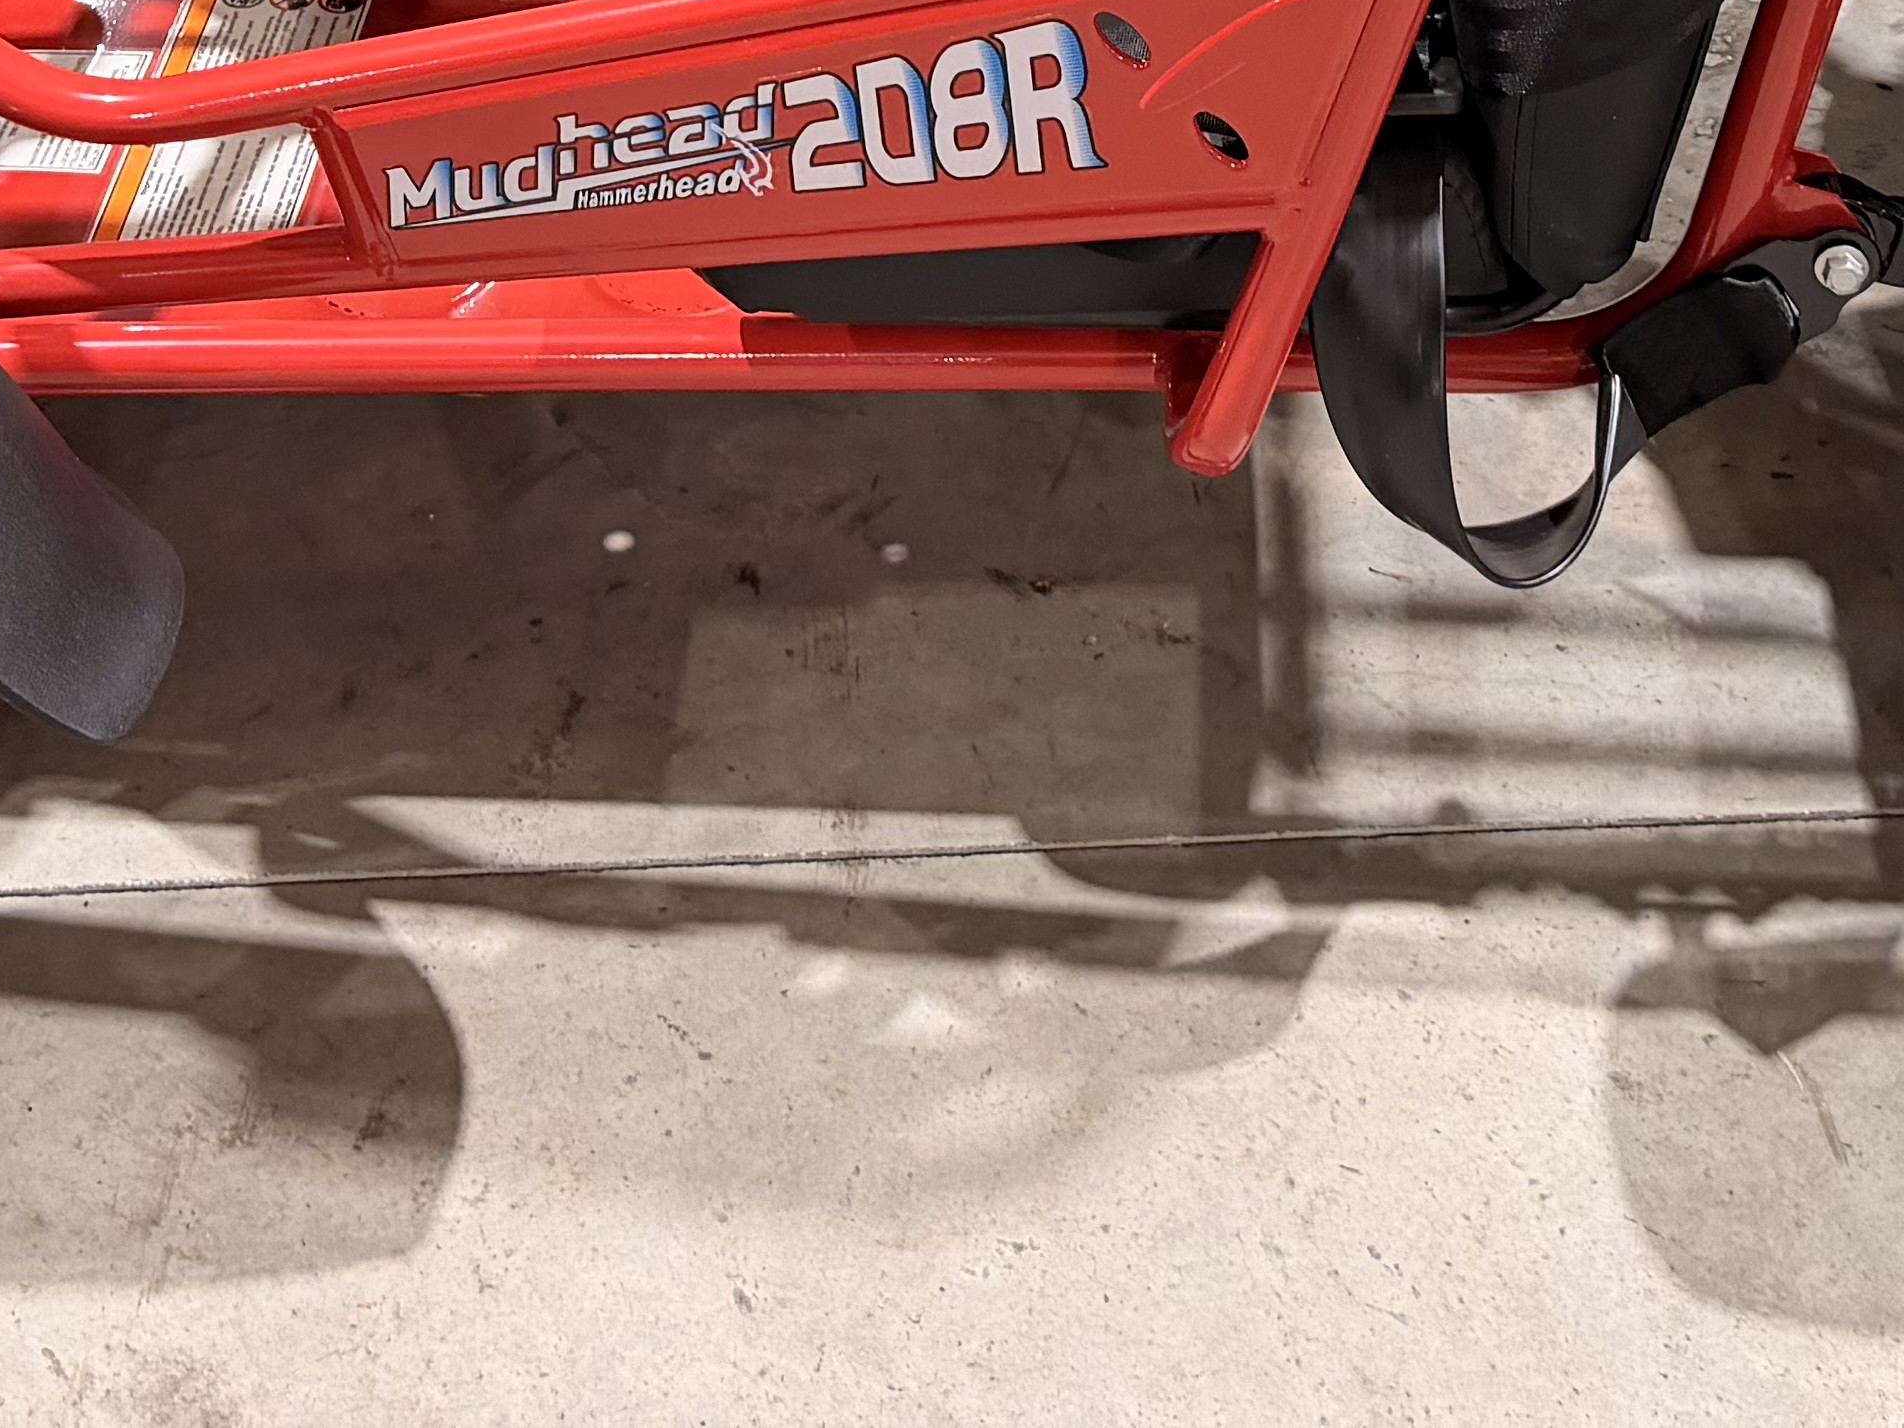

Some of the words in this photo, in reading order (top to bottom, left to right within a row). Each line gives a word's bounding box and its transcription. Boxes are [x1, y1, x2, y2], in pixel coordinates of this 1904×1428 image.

[385, 81, 779, 229] Mudhead
[782, 19, 1109, 194] 208R
[576, 159, 744, 211] Hammerhead
